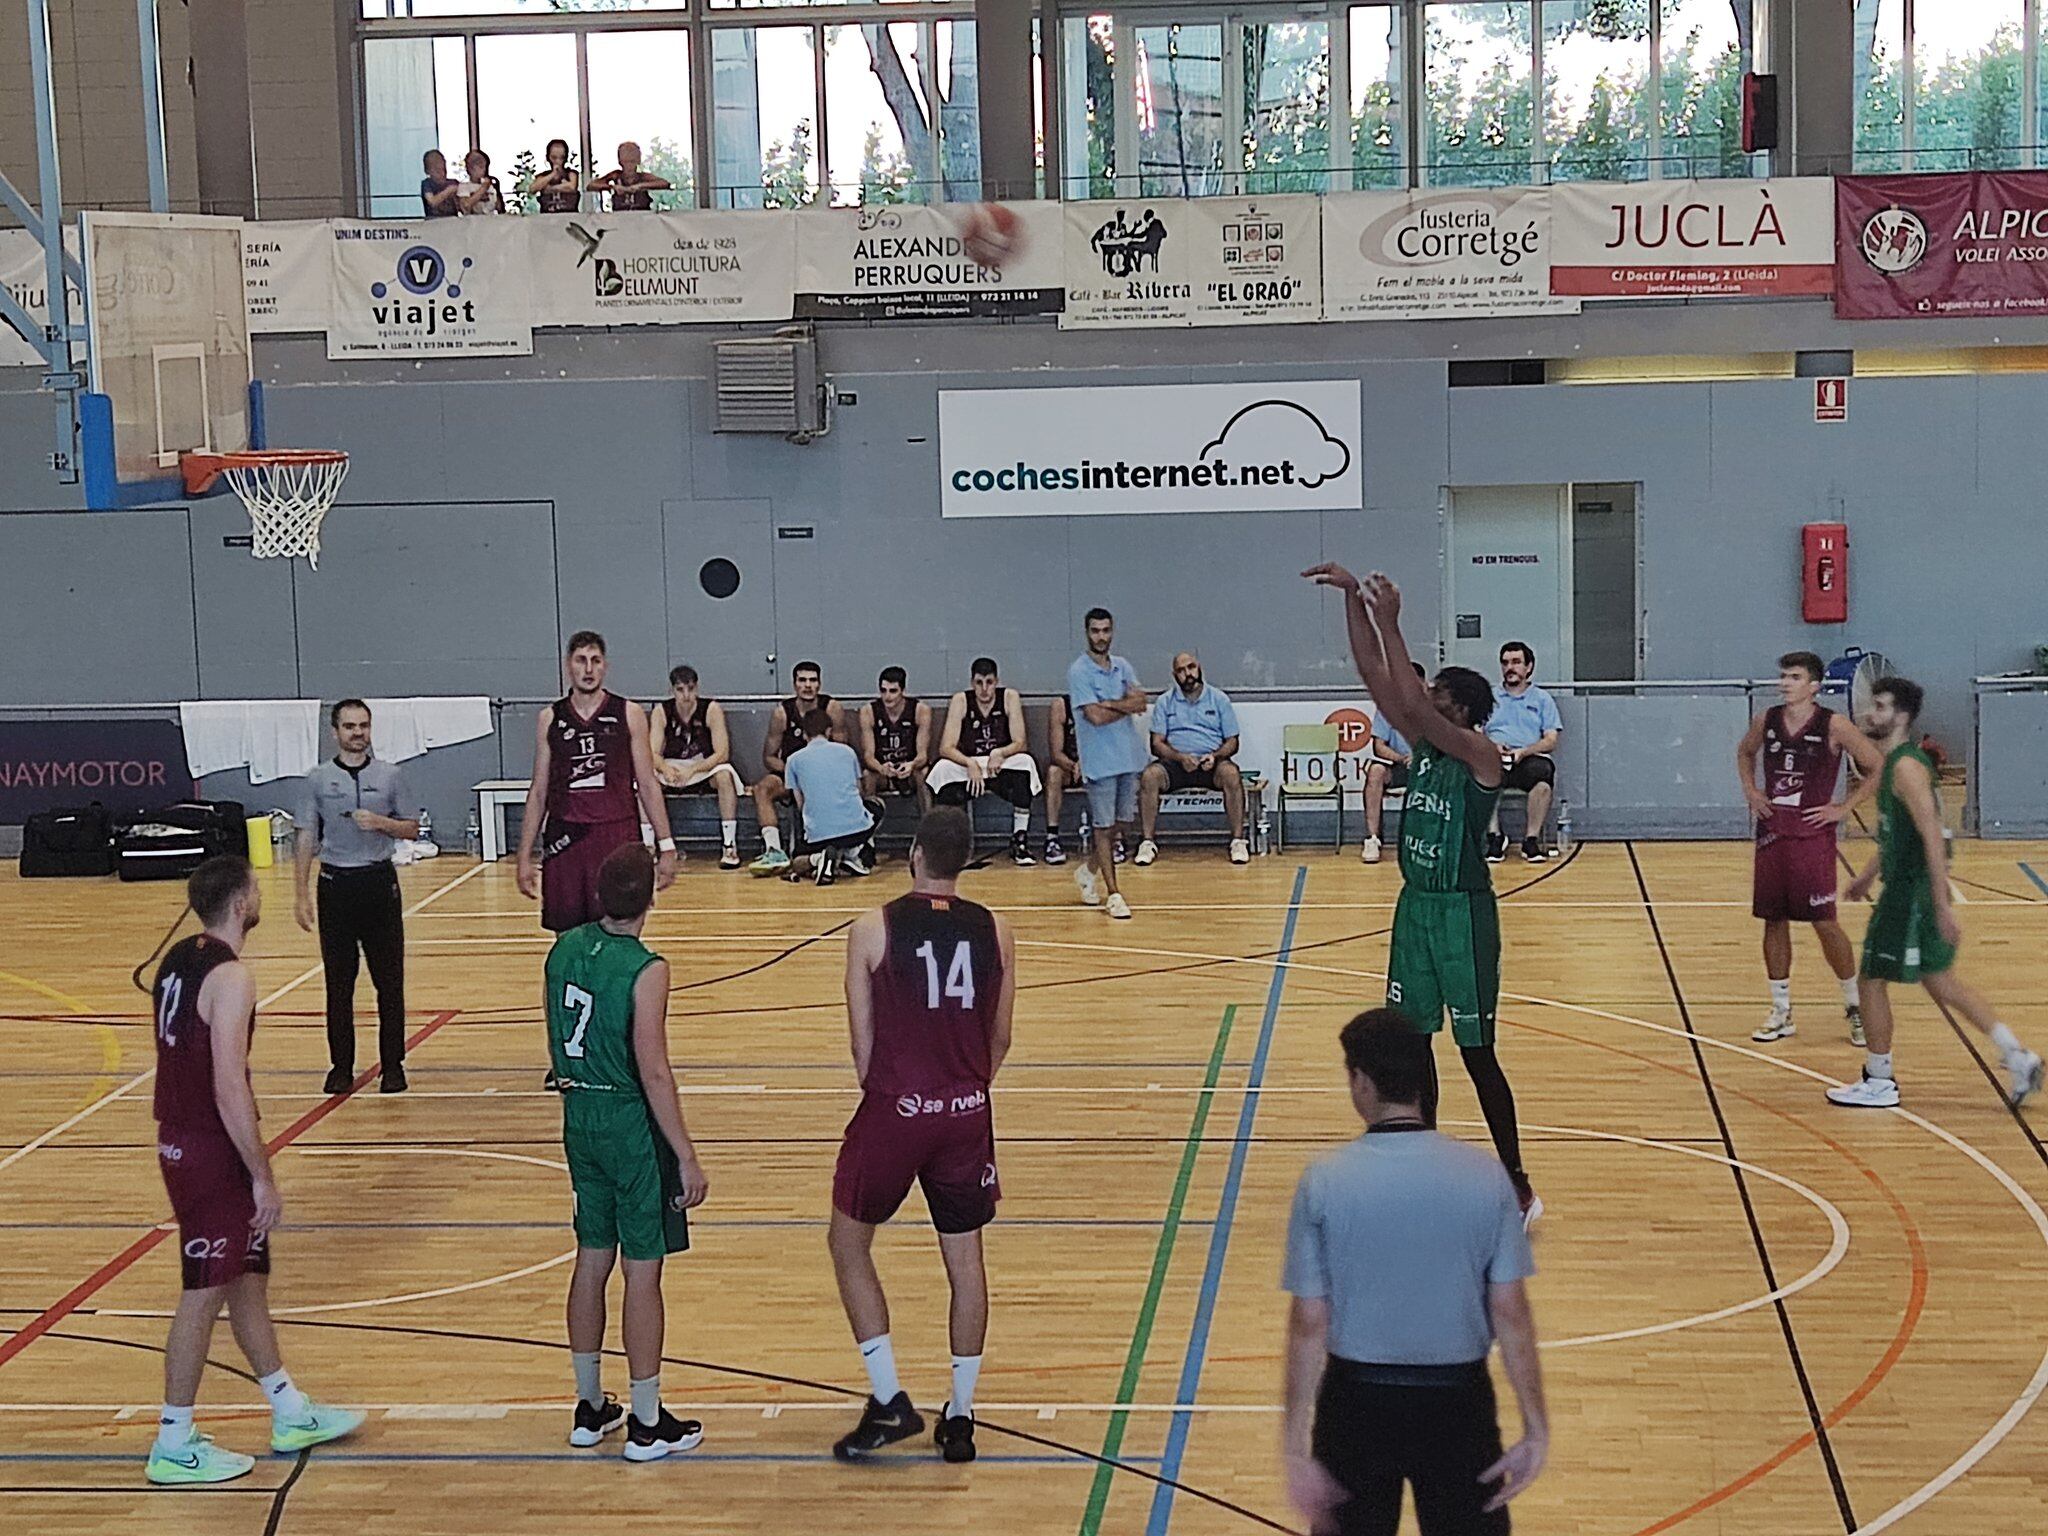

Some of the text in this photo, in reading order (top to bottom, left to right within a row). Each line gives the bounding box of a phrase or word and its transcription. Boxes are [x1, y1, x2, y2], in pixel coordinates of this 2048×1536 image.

[1420, 209, 1490, 229] fusteria
[1605, 188, 1786, 249] JUCLÀ
[1953, 209, 2048, 241] ALPIC
[246, 242, 281, 254] SERÍA
[854, 237, 969, 260] ALEXAND
[1397, 221, 1539, 267] Corretgé
[1955, 247, 2000, 263] VOLEI
[623, 256, 741, 274] HORTICULTURA
[855, 263, 1002, 287] PERRUQUERS
[1611, 268, 1778, 283] C/ Doctor Fleming, 2 (Lleida)
[595, 258, 700, 297] BELLMUNT
[1208, 276, 1301, 302] "EL GRAÓ"
[1377, 276, 1399, 288] Fem
[1473, 276, 1494, 285] seva
[1499, 272, 1523, 284] mida
[981, 292, 998, 301] 973
[1126, 281, 1191, 300] Ribera
[372, 299, 475, 335] viajet
[951, 458, 1295, 492] cochesinternet.net
[579, 737, 595, 754] 13
[0, 761, 166, 788] NAYMOTOR
[916, 940, 975, 1010] 14
[159, 971, 182, 1047] 12
[564, 982, 594, 1059] 7
[184, 1237, 227, 1259] Q2
